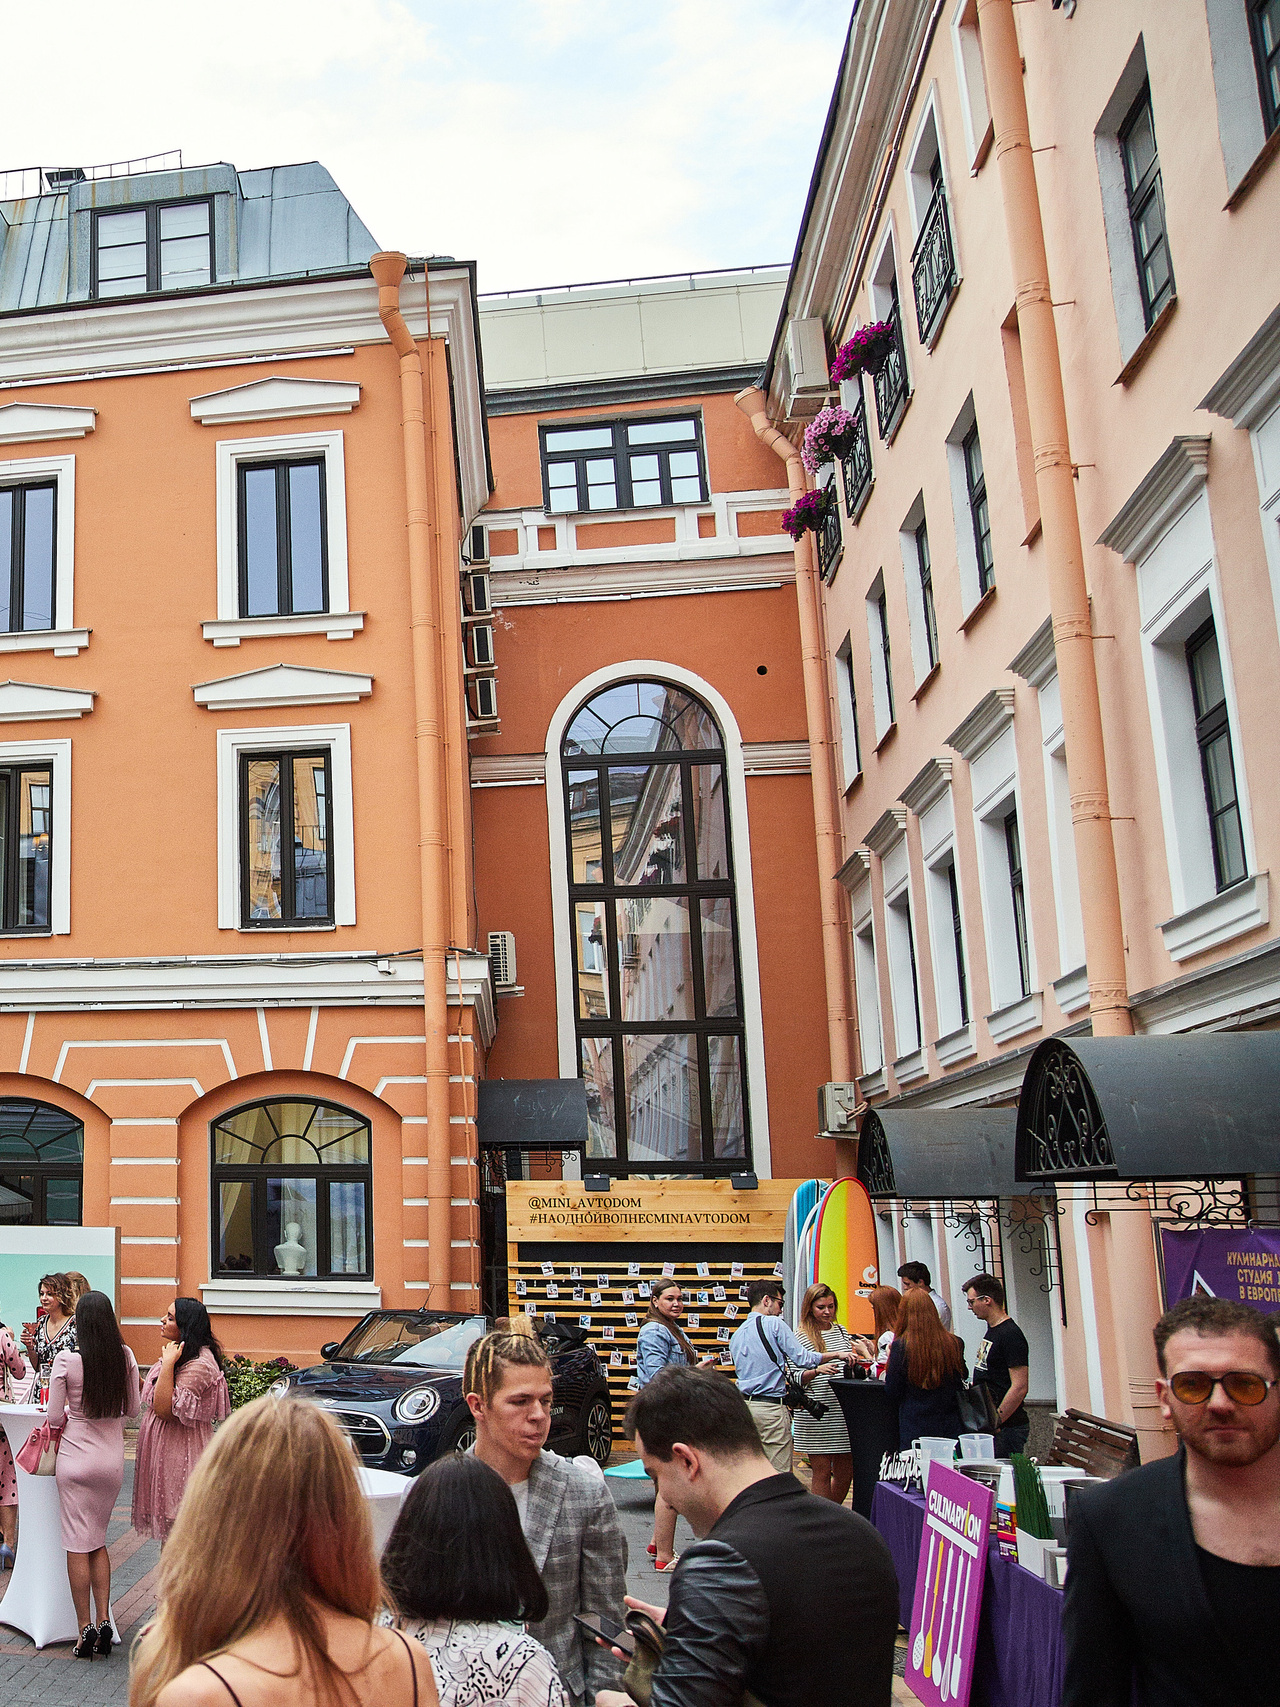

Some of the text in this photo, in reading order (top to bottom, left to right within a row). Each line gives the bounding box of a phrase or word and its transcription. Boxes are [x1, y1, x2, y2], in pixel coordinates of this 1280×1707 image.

[528, 1197, 642, 1210] @MINI_AVTODOM
[1226, 1251, 1280, 1268] КУЛИНАРНА
[1237, 1268, 1273, 1285] СТУДИЯ
[1239, 1285, 1246, 1300] В
